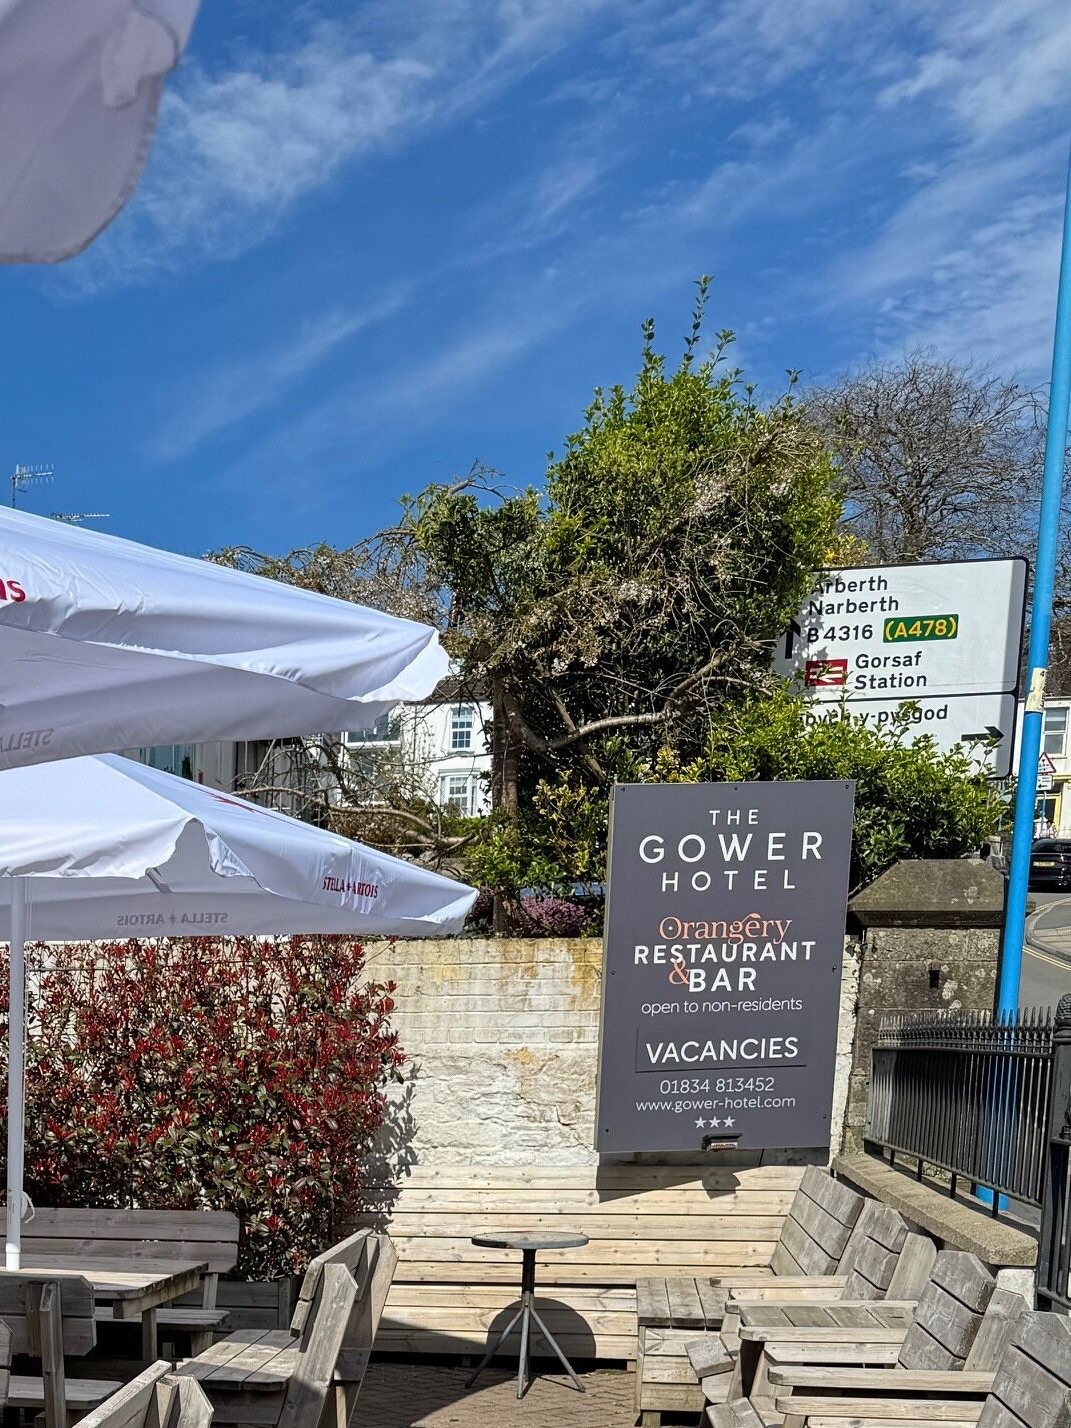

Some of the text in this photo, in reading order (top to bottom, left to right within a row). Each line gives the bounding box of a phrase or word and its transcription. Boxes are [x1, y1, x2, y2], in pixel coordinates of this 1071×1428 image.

[808, 596, 899, 615] Narberth
[855, 651, 922, 669] Gorsaf
[854, 673, 927, 690] Station
[709, 809, 759, 826] THE
[639, 831, 823, 864] GOWER
[352, 881, 379, 898] ARTOIS
[661, 869, 796, 892] HOTEL
[634, 941, 816, 965] RESTAURANT
[641, 997, 803, 1017] open to non-residents
[646, 1037, 798, 1064] VACANCIES
[660, 1077, 775, 1094] 01834 813452
[636, 1095, 796, 1113] www.gower-hotel.com
